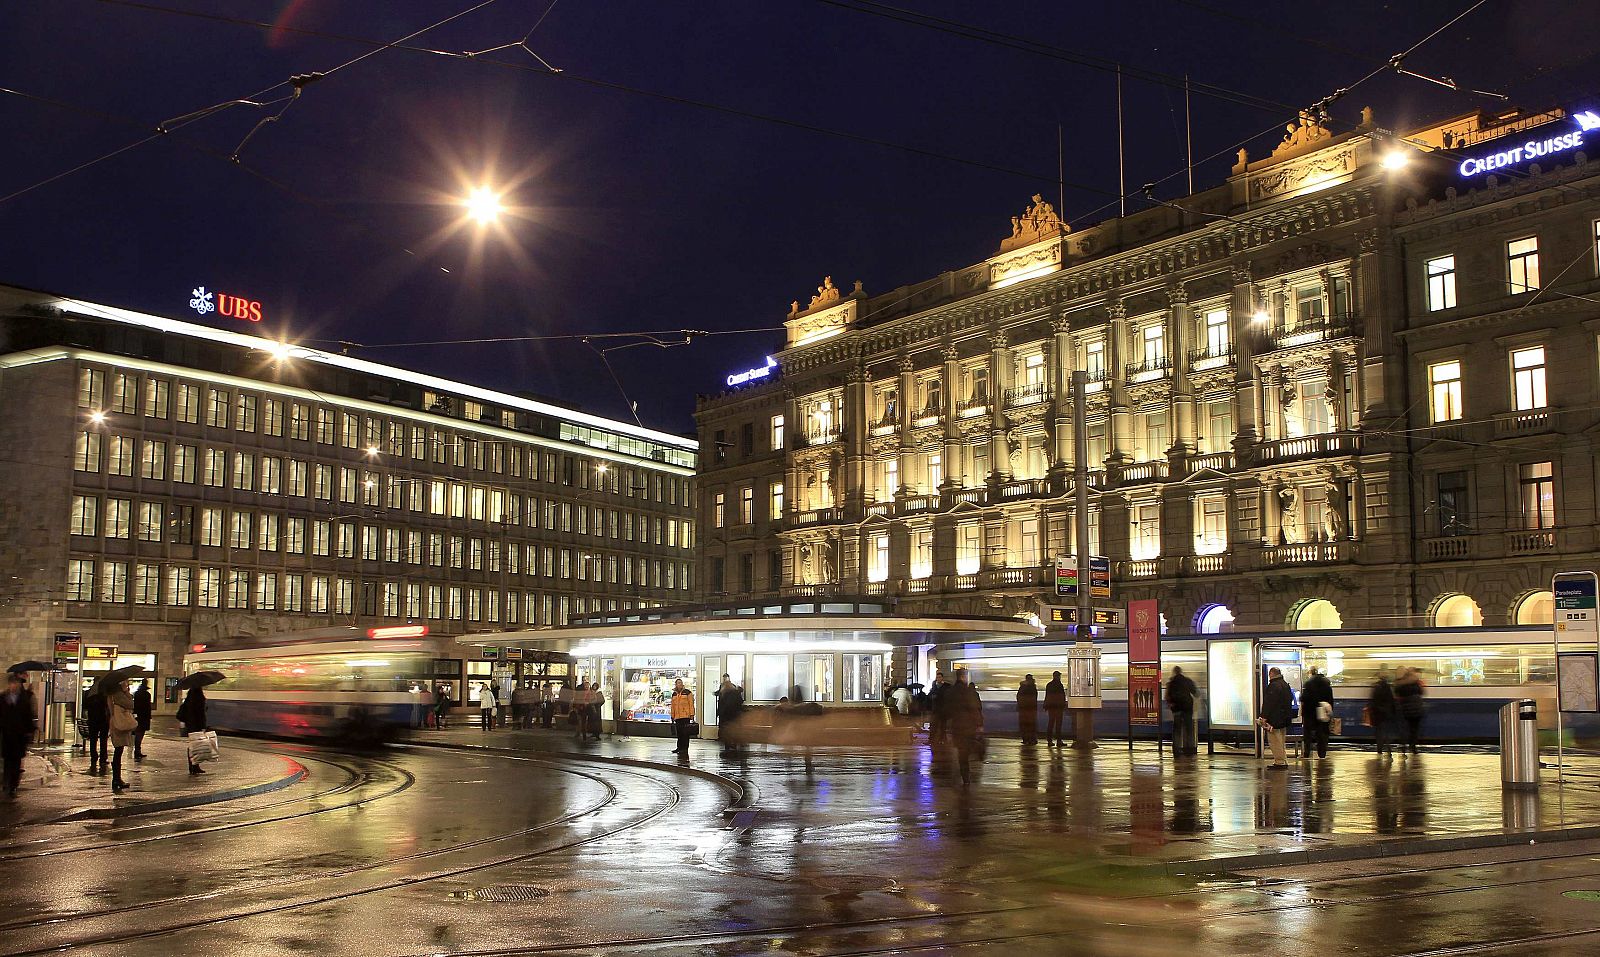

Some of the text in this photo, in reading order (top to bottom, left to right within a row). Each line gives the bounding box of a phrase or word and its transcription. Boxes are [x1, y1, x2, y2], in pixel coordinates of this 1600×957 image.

[1460, 131, 1584, 177] CREDIT SUISSE
[218, 293, 262, 322] UBS
[727, 371, 750, 386] CREDIT
[1559, 600, 1566, 608] 11
